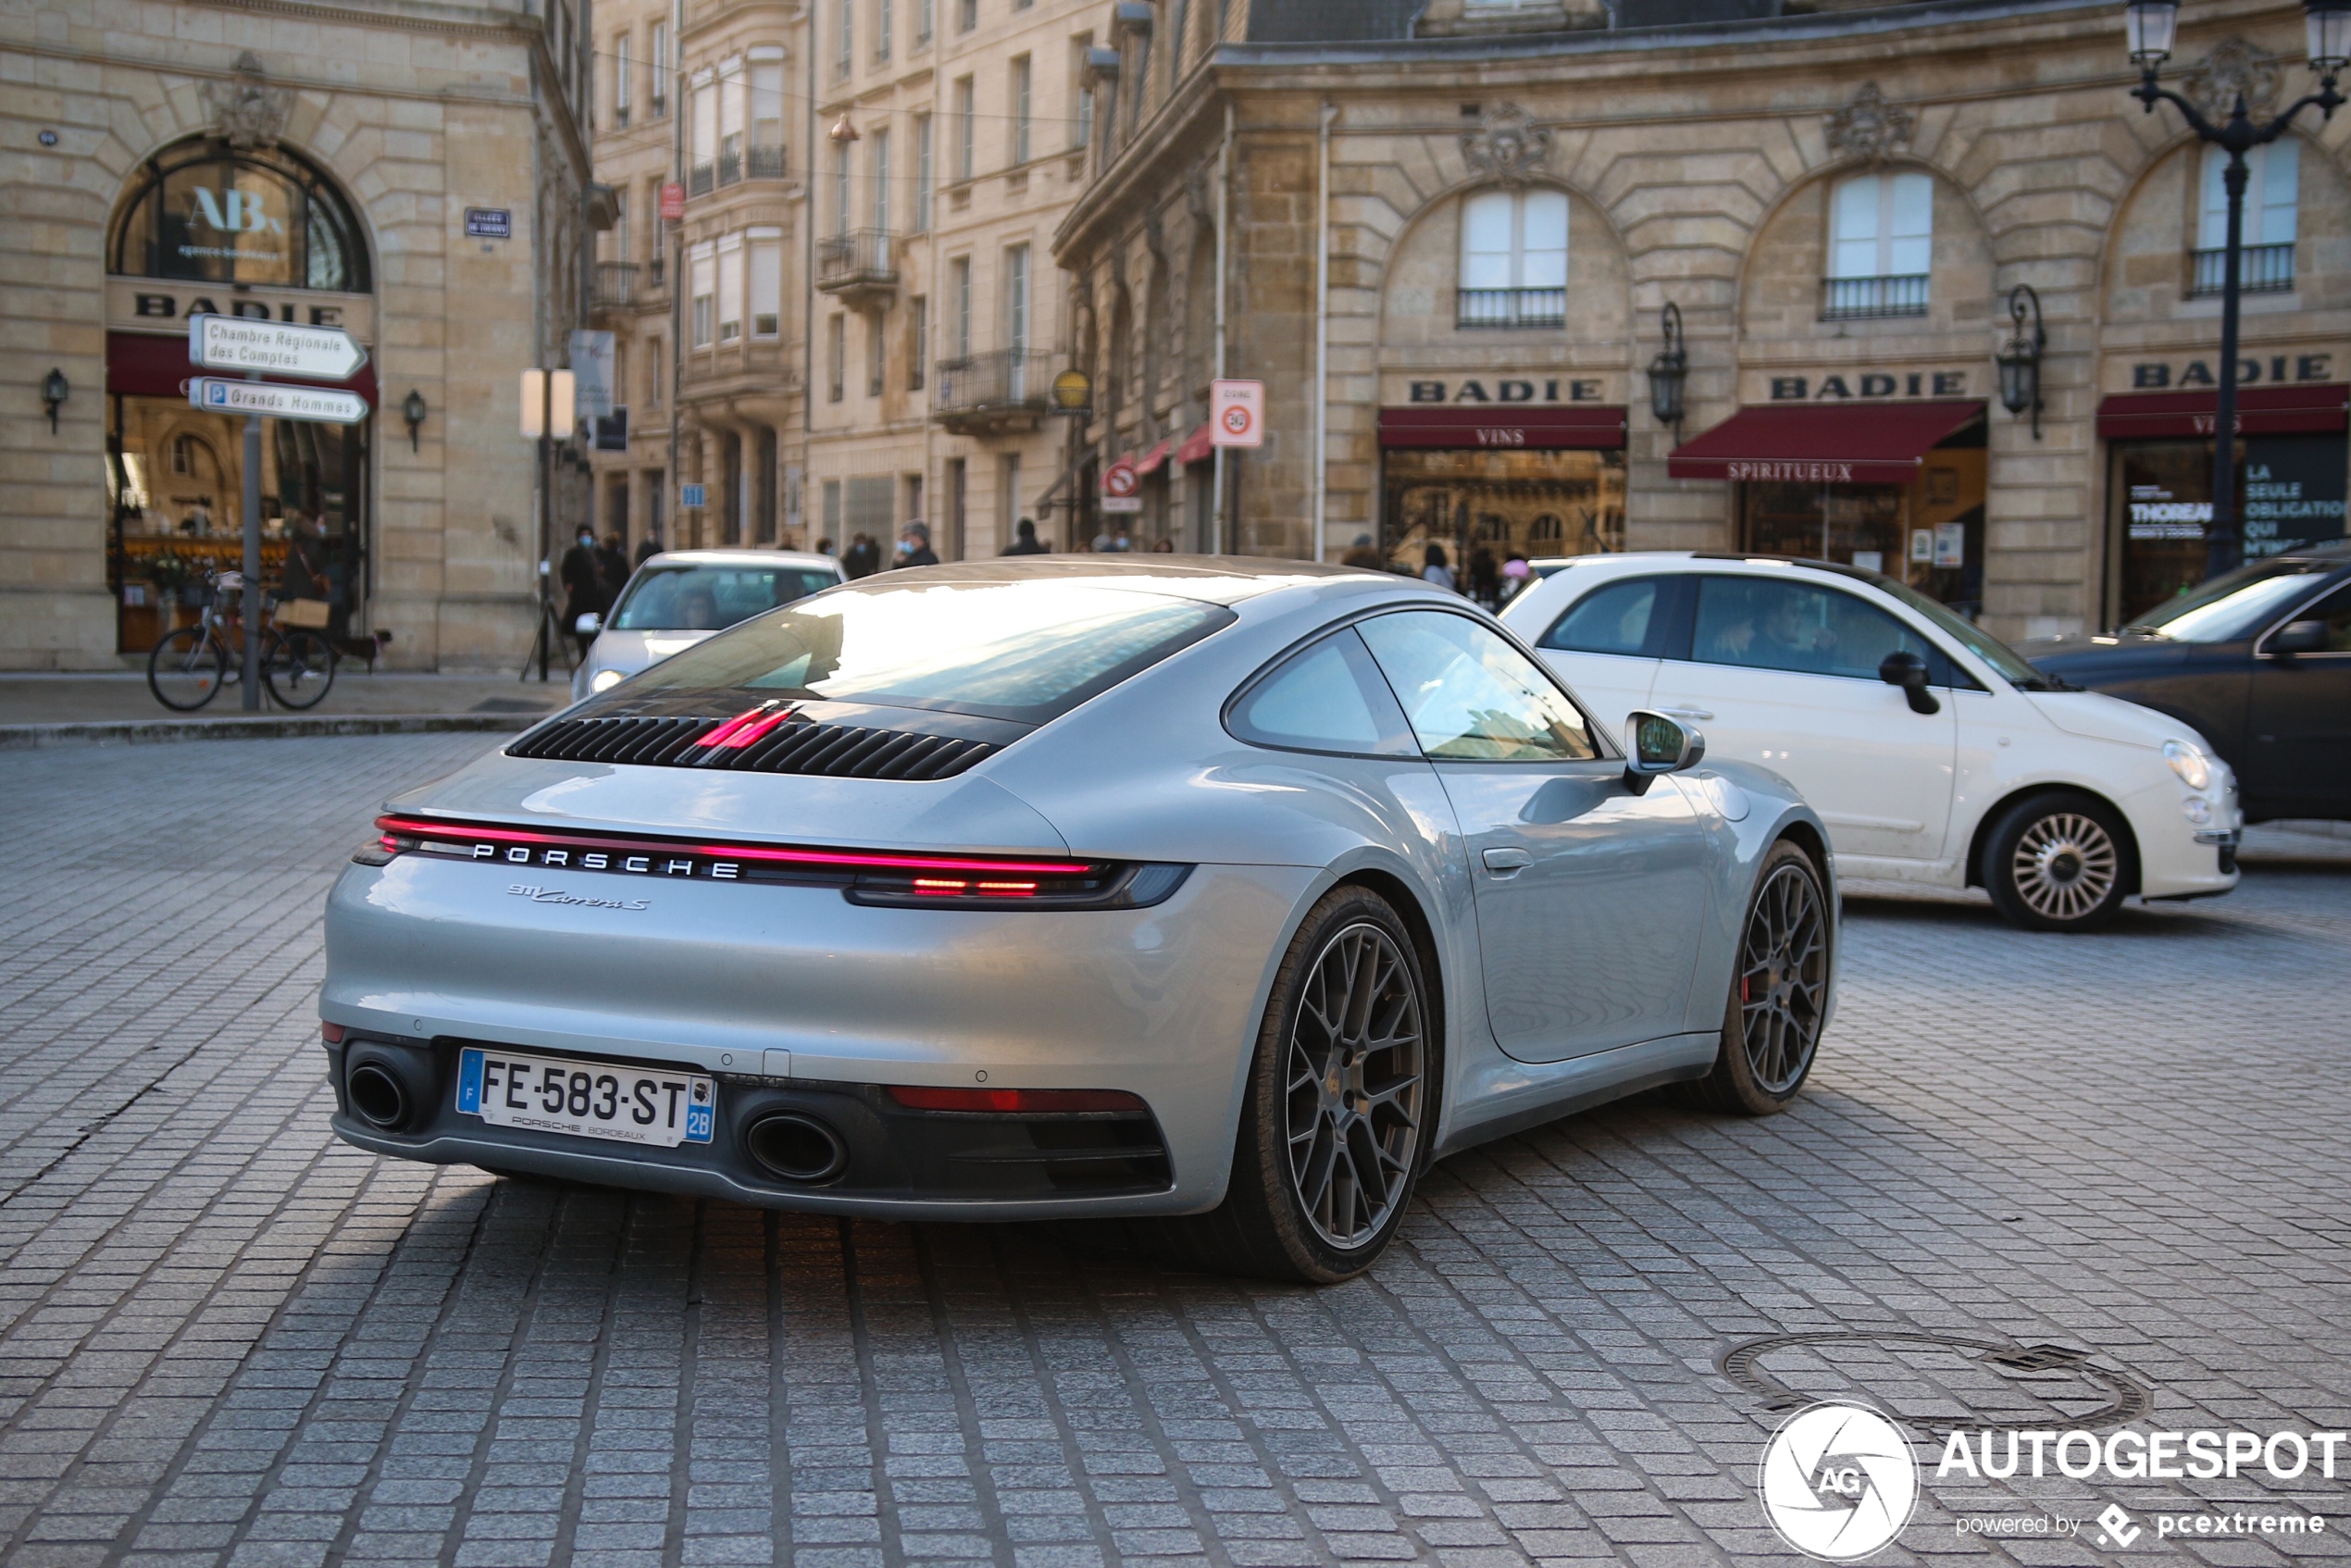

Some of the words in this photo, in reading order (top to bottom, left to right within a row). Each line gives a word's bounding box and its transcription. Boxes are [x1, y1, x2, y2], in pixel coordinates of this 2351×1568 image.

[209, 323, 270, 345] Chambre
[275, 329, 342, 352] Régionale
[209, 344, 232, 359] des
[239, 345, 299, 367] Comptes
[1224, 389, 1250, 399] ZONE
[1410, 378, 1605, 403] BADIE
[1771, 371, 1967, 400] BADIE
[231, 388, 284, 408] Grands
[291, 394, 352, 415] Hommes
[1227, 412, 1247, 426] 30
[2193, 414, 2243, 434] VIS
[1475, 428, 1525, 447] VINS
[1727, 463, 1852, 482] SPIRITUEUX
[2246, 464, 2271, 479] LA
[2246, 482, 2302, 498] SEULE
[2245, 520, 2278, 538] QUI
[472, 843, 740, 879] PORSCHE
[507, 883, 543, 896] 911
[531, 890, 623, 909] Carrera
[622, 899, 651, 910] S
[466, 1087, 474, 1101] F
[481, 1059, 687, 1128] FE-583-ST
[512, 1115, 581, 1133] PORSCHE
[588, 1125, 646, 1140] BORDEAUX
[688, 1111, 711, 1136] 2B
